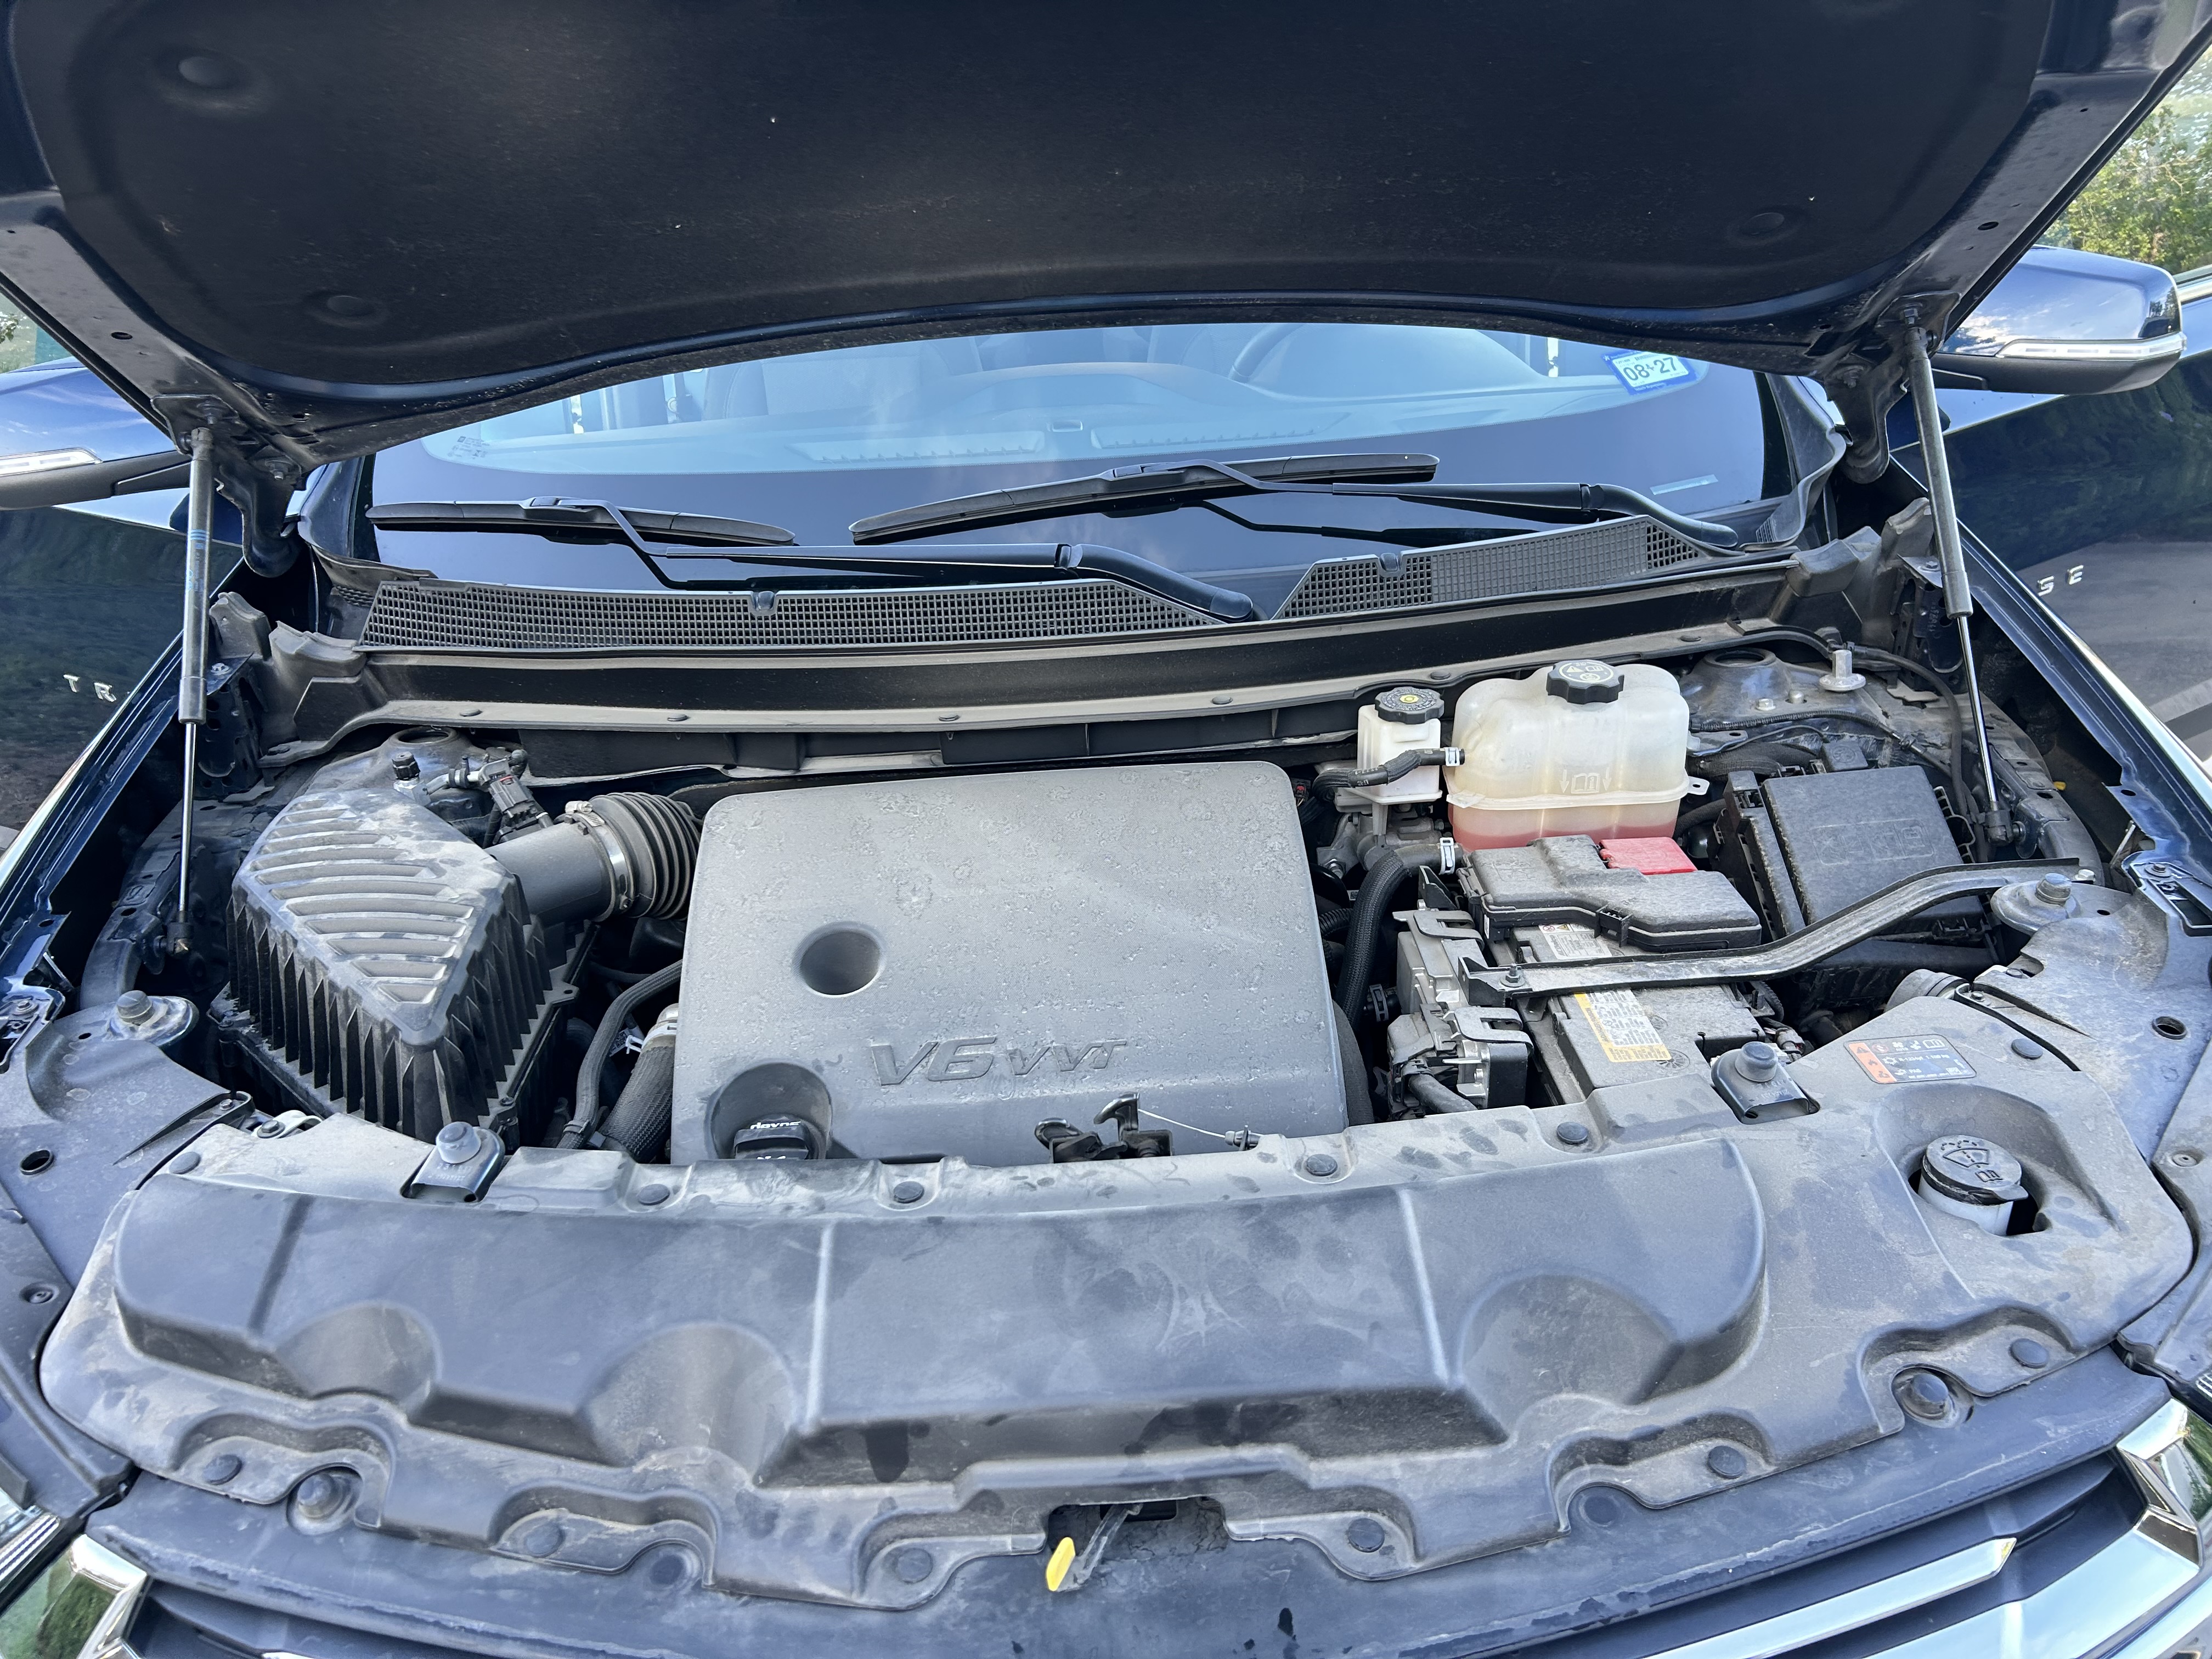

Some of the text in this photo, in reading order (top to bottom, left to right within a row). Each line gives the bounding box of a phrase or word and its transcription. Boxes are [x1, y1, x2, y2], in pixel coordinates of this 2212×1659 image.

[1623, 357, 1678, 381] 08 27
[871, 1036, 1128, 1087] V6 VVT
